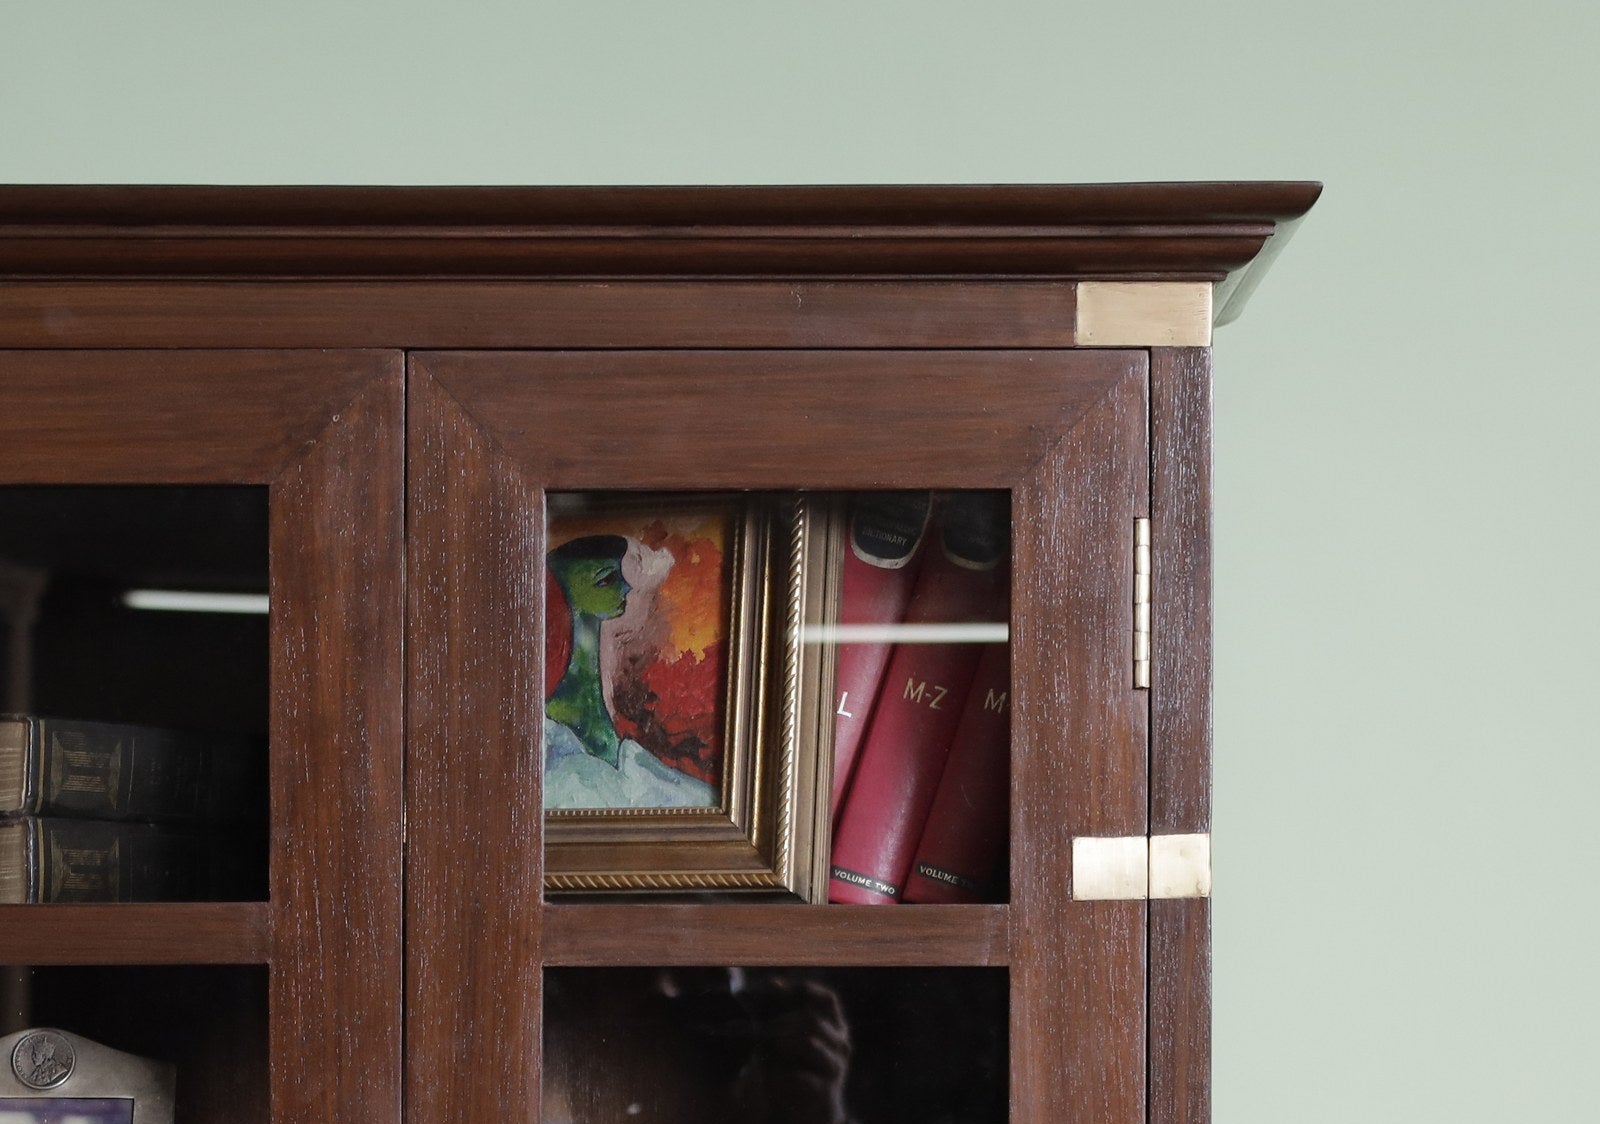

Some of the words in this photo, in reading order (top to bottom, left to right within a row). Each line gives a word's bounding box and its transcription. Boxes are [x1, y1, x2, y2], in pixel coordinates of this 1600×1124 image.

[903, 677, 948, 710] M-Z
[834, 869, 872, 888] VOLUME
[875, 882, 896, 896] TWO
[919, 865, 959, 885] VOLUME
